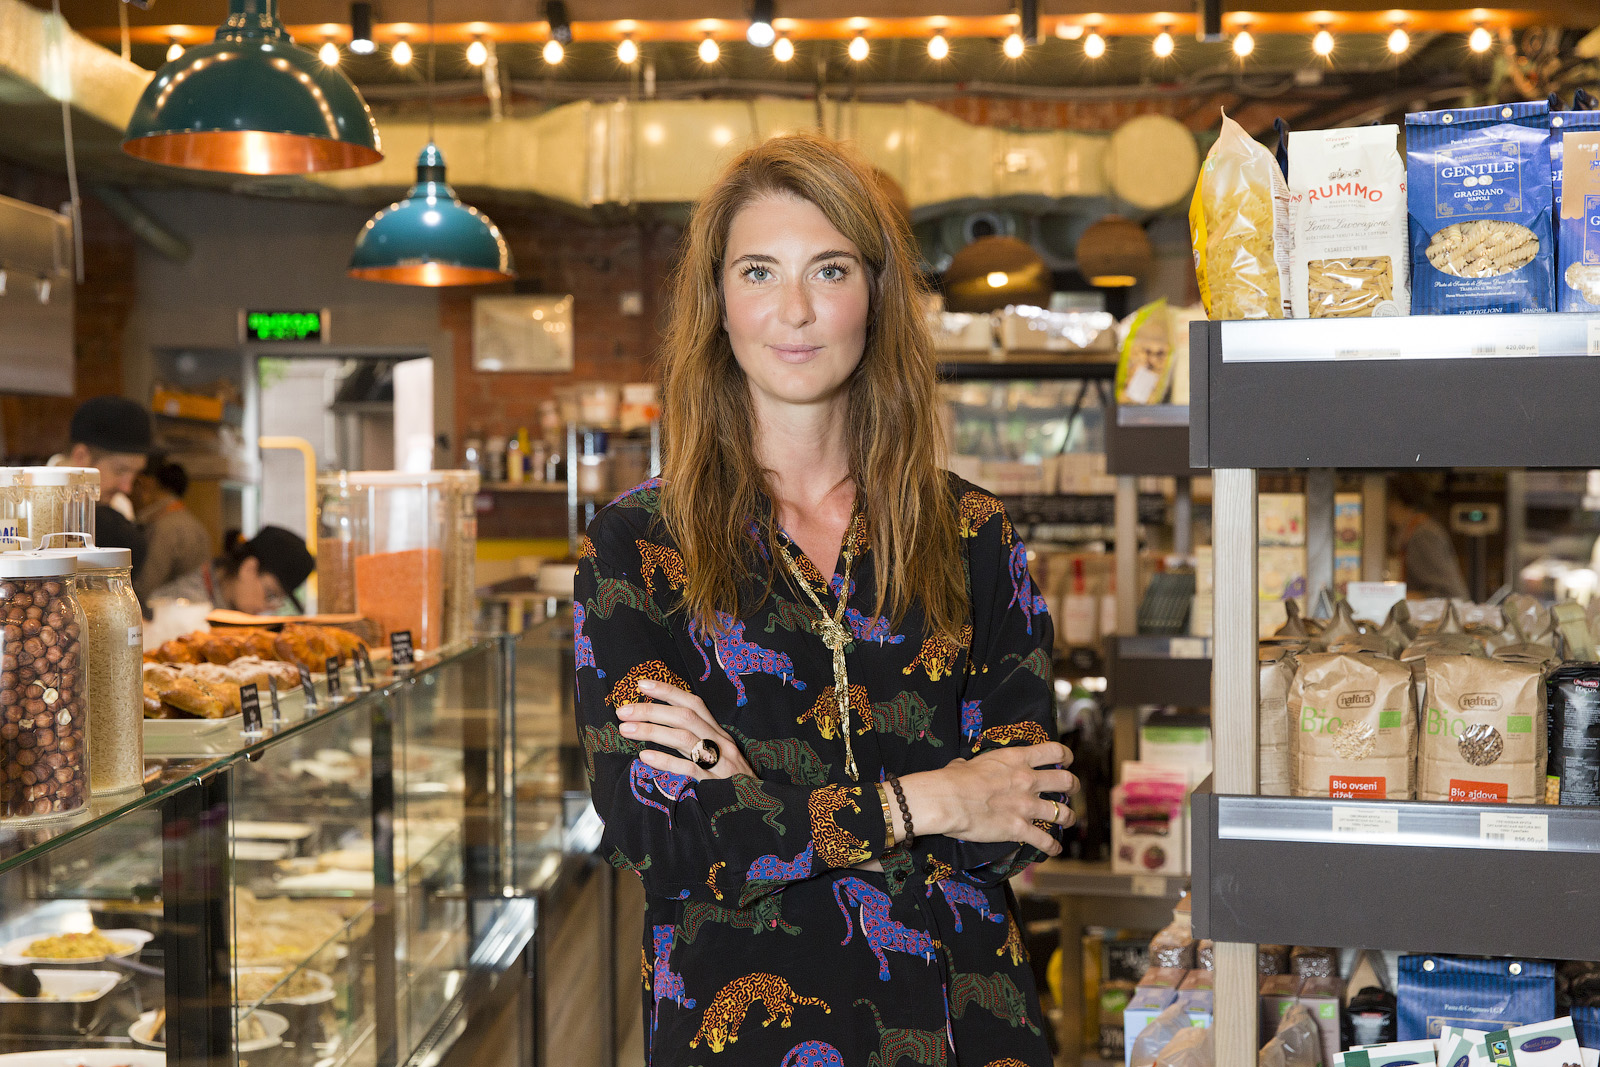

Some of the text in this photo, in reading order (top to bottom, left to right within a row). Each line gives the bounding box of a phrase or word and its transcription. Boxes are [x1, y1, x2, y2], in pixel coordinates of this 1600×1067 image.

[1441, 161, 1515, 179] GENTILE
[1309, 182, 1383, 204] RUMMO
[1453, 188, 1504, 199] GRAGNANO
[1459, 307, 1503, 315] TORTIGLIONI
[1301, 706, 1342, 734] Bio
[1427, 707, 1467, 738] Bio
[1333, 780, 1377, 790] Bio ovseni
[1451, 788, 1498, 800] Bio ajdova
